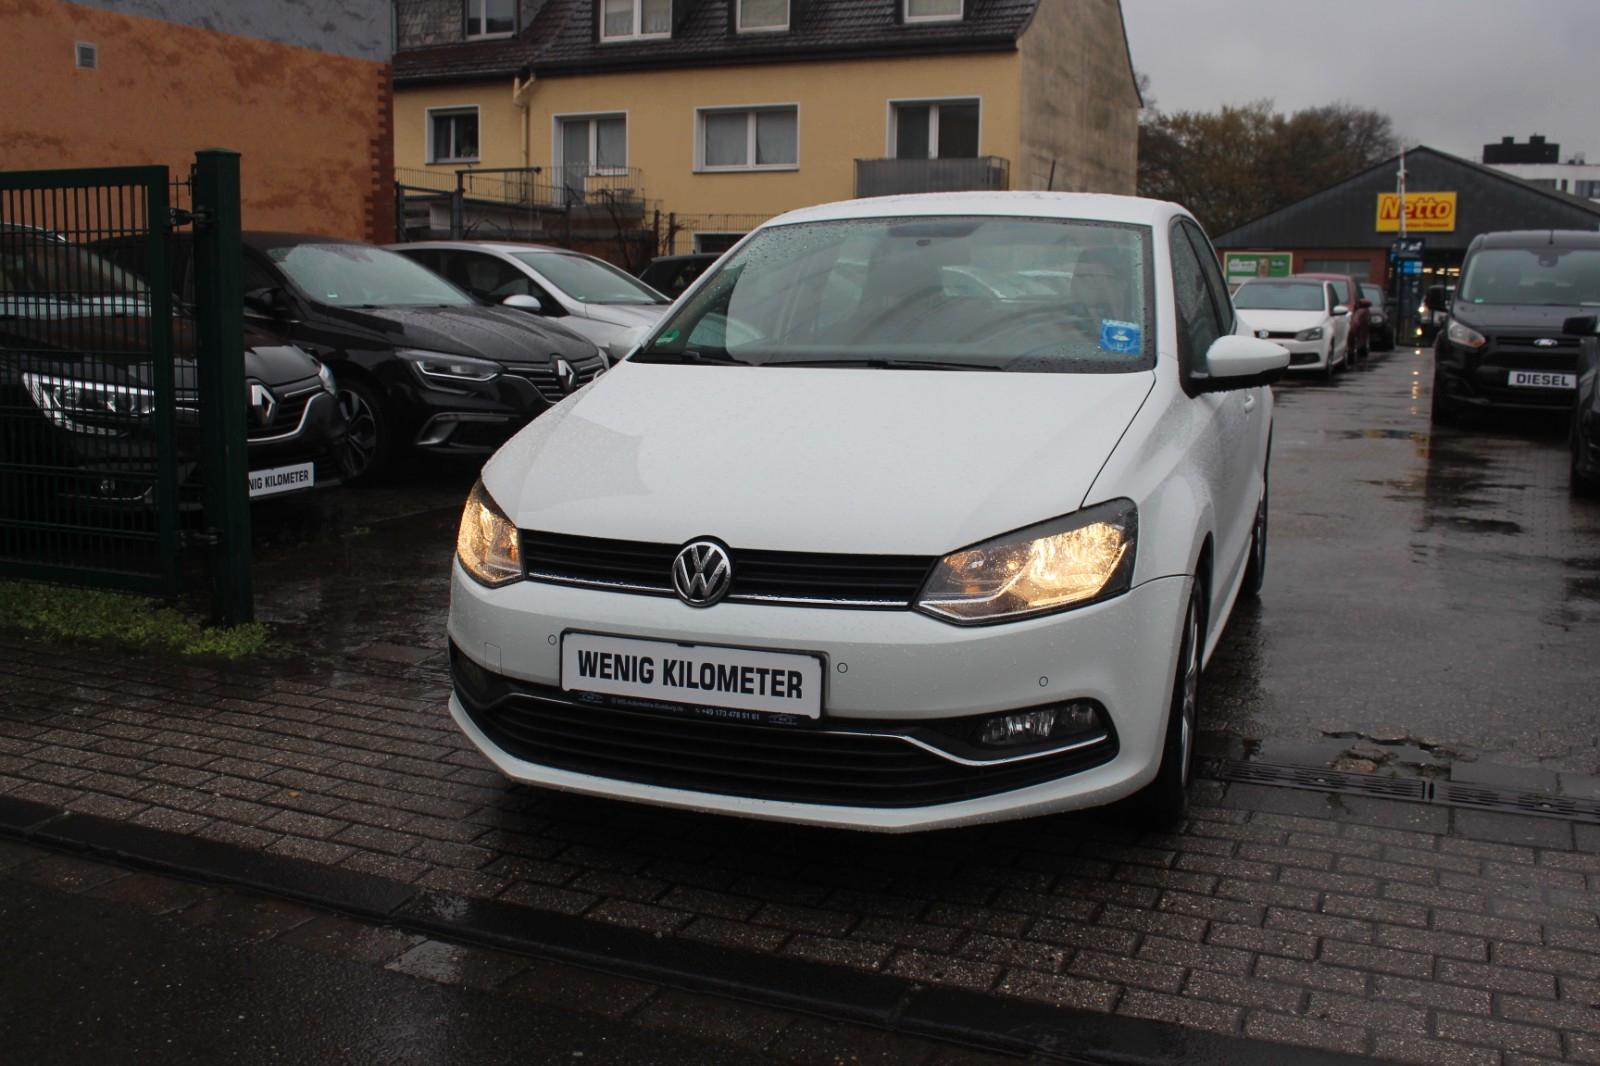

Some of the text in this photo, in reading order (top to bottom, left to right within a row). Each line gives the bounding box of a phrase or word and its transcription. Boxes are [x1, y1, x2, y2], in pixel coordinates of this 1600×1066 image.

[1380, 196, 1452, 219] Netto
[1516, 373, 1569, 387] DIESEL
[265, 470, 309, 489] KILOMETER
[578, 650, 803, 699] WENIG KILOMETER
